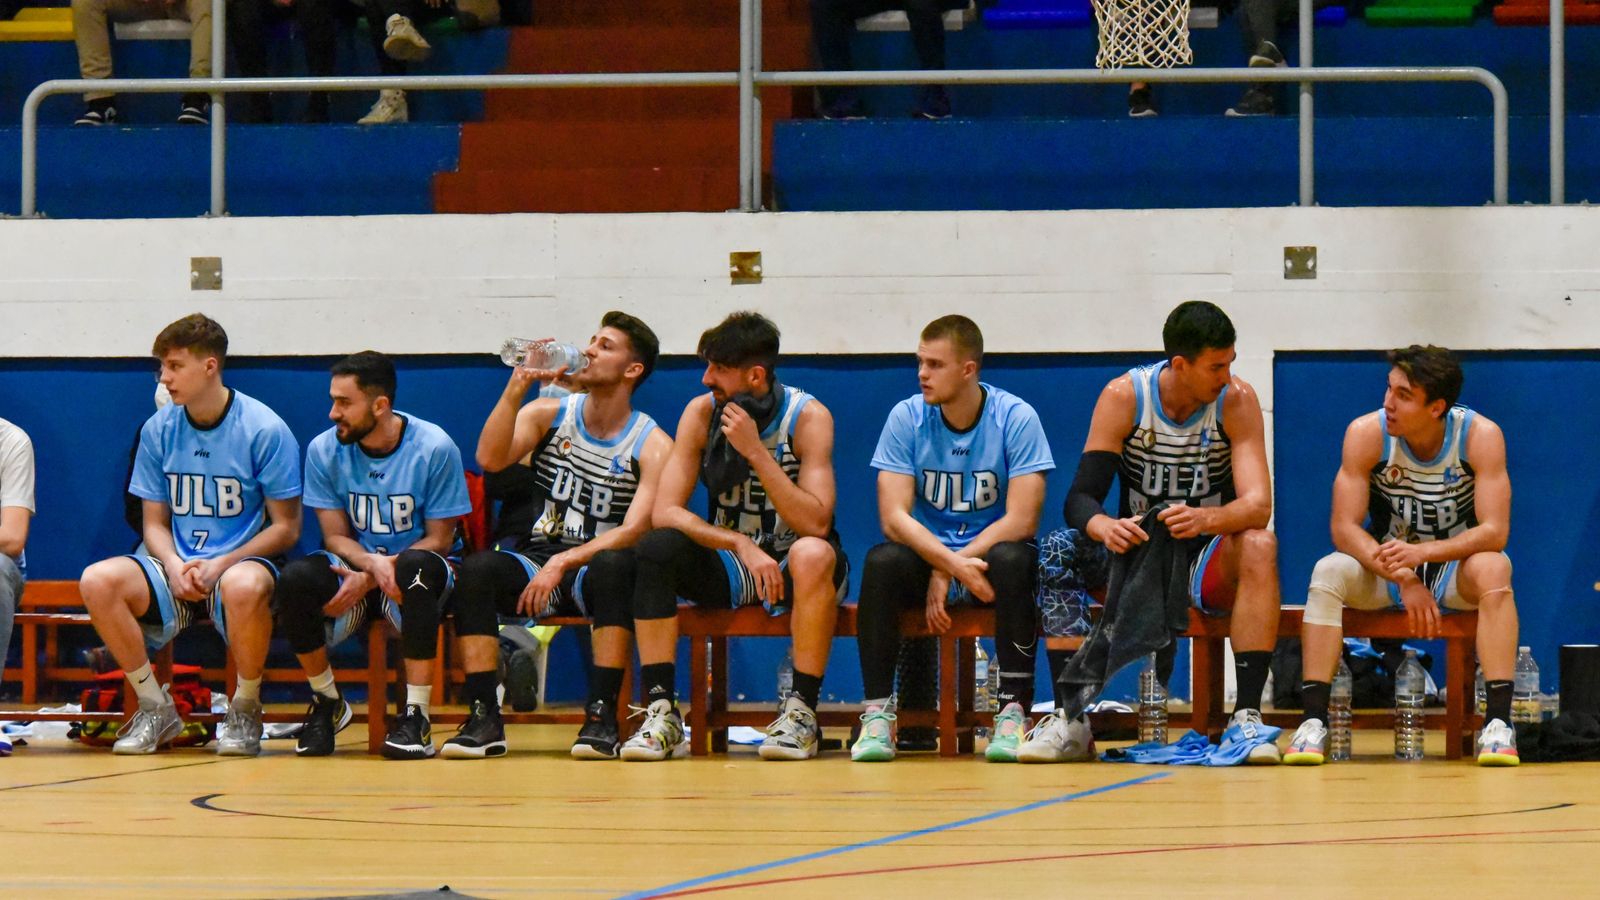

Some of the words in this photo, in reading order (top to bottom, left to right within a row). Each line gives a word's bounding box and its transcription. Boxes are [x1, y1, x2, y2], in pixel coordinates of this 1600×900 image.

[952, 446, 970, 456] vive
[165, 473, 244, 518] ULB
[551, 465, 613, 519] ULB
[922, 468, 999, 513] ULB
[1141, 461, 1210, 498] ULB
[349, 491, 415, 534] ULB
[191, 530, 209, 551] 7
